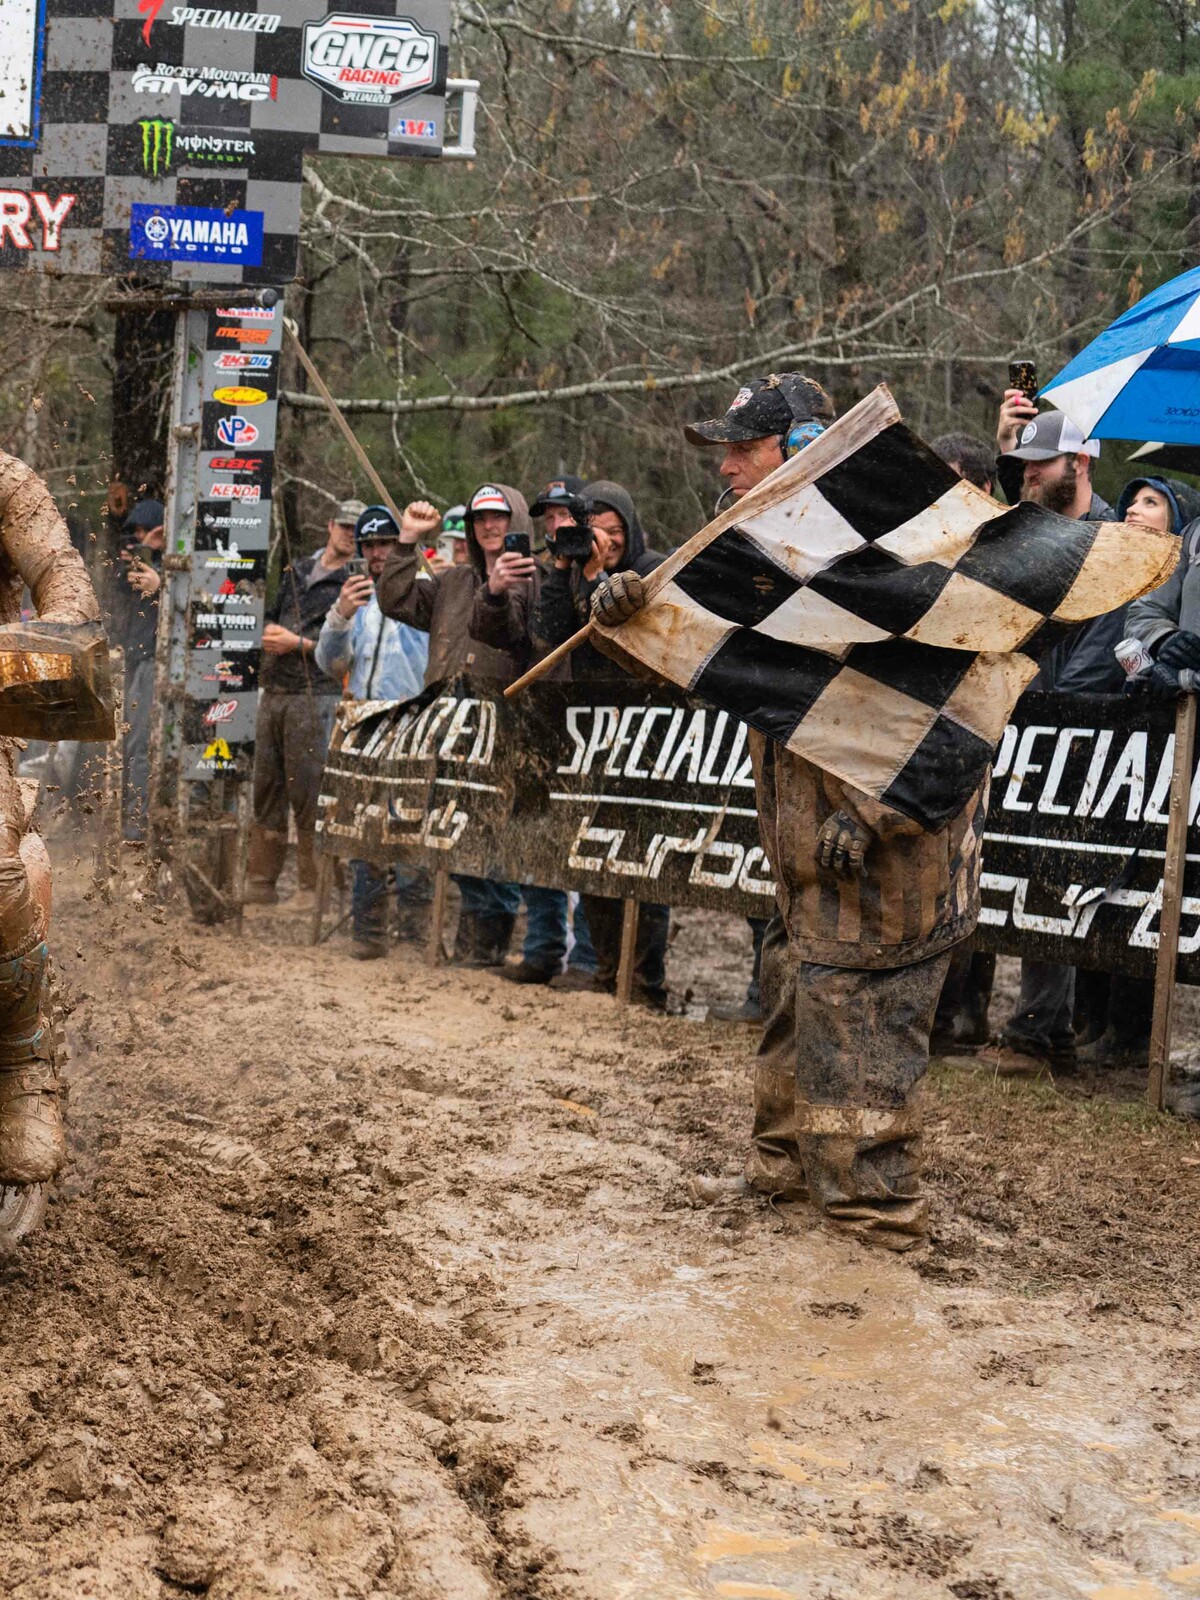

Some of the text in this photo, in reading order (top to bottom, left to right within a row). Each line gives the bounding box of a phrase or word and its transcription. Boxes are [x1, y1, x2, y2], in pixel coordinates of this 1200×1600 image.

[167, 6, 281, 33] SPECIALIZED
[311, 30, 430, 73] GNCC
[154, 62, 271, 84] ROCKY MOUNTAIN
[339, 67, 402, 86] RACING
[341, 91, 393, 104] SPECIALIZED
[175, 134, 257, 155] MONSTER
[187, 152, 244, 163] ENERGY
[168, 218, 249, 247] YAMAHA
[152, 242, 244, 255] RACING
[219, 416, 247, 444] VP
[209, 457, 263, 471] GBC
[210, 484, 260, 498] KENDA
[215, 516, 262, 526] DUNLOP
[204, 561, 255, 570] MICHELIN
[196, 614, 257, 625] METHOD
